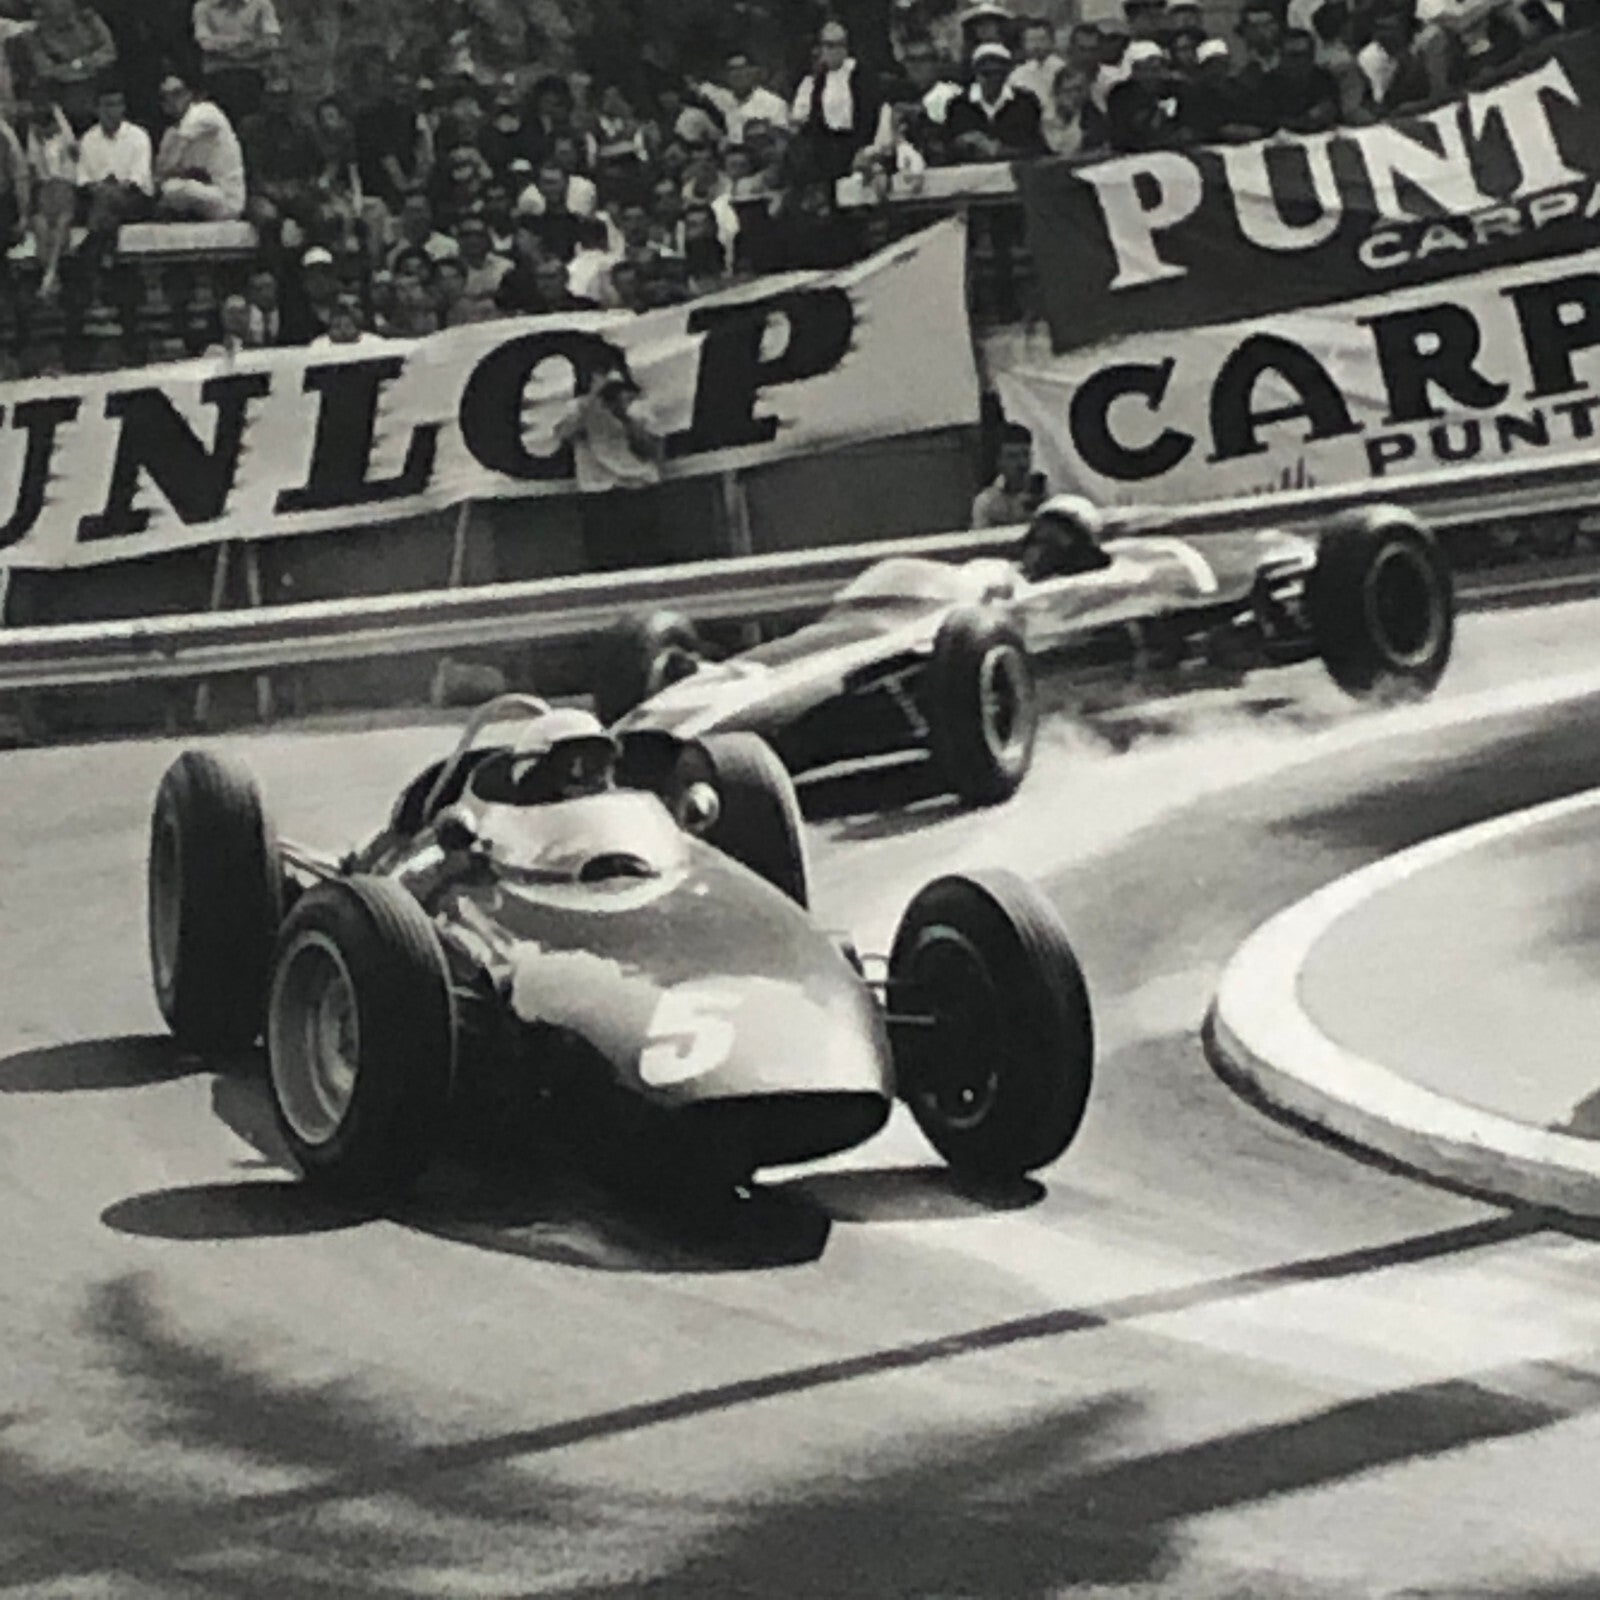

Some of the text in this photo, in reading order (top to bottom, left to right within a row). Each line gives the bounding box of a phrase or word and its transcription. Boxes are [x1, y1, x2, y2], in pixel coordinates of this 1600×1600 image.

[1071, 56, 1590, 290] PUNT
[1358, 182, 1600, 269] CARP
[1068, 273, 1600, 482] CARP
[1365, 395, 1600, 477] PUNT
[639, 989, 742, 1086] 5
